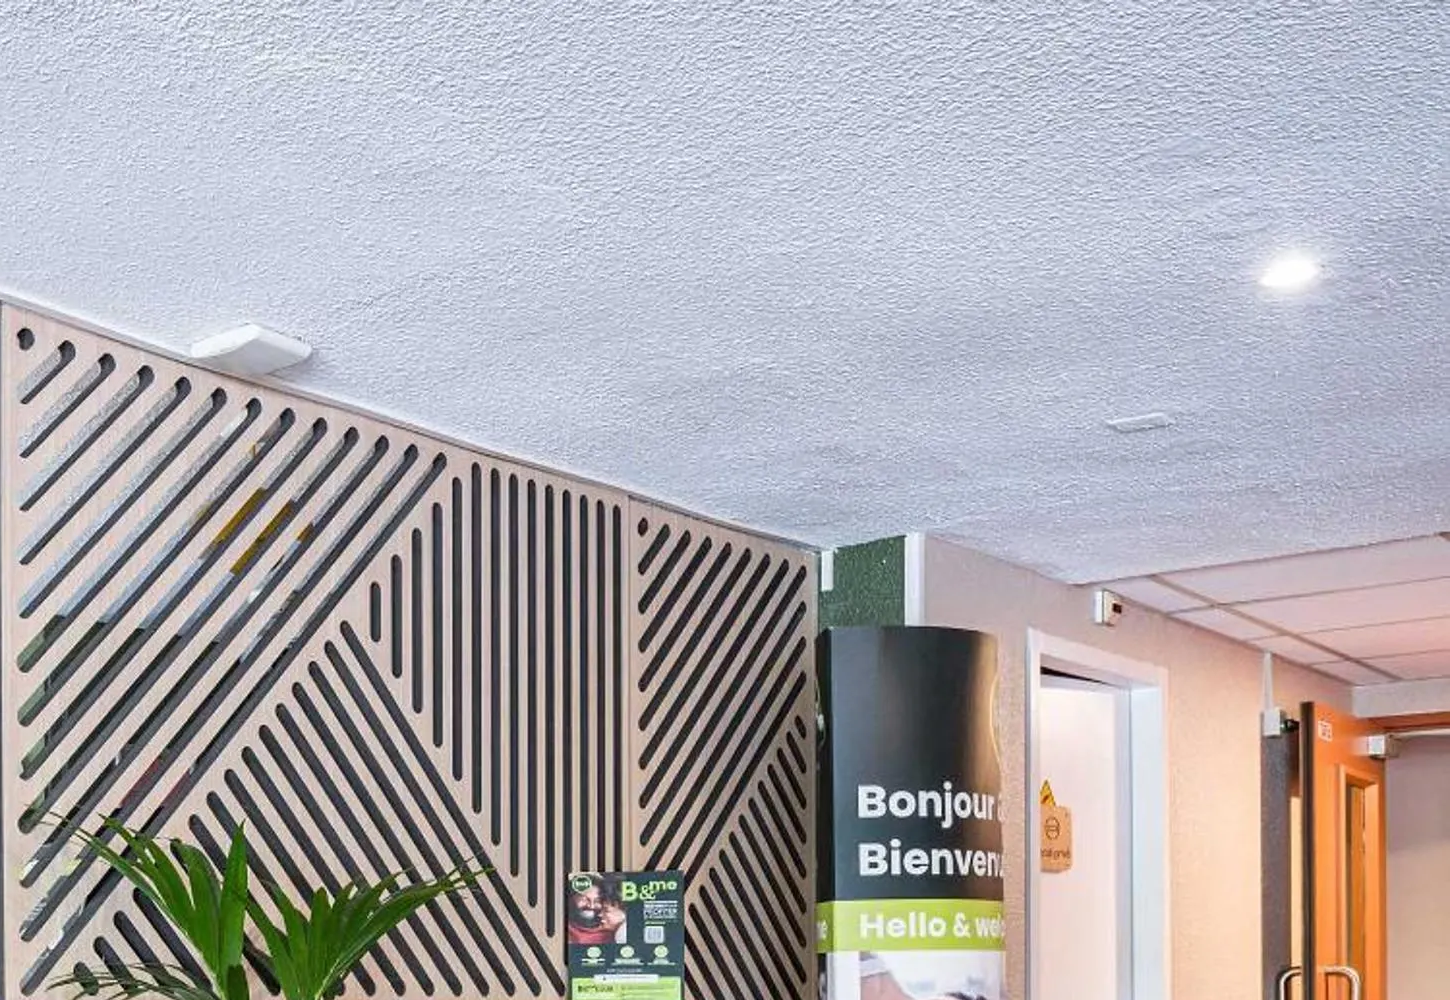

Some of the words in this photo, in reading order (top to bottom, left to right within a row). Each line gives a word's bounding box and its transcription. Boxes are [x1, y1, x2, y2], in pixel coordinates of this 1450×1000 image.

[857, 781, 995, 828] Bonjour
[858, 839, 1004, 877] Bienven
[859, 912, 946, 938] Hello
[953, 913, 971, 938] &
